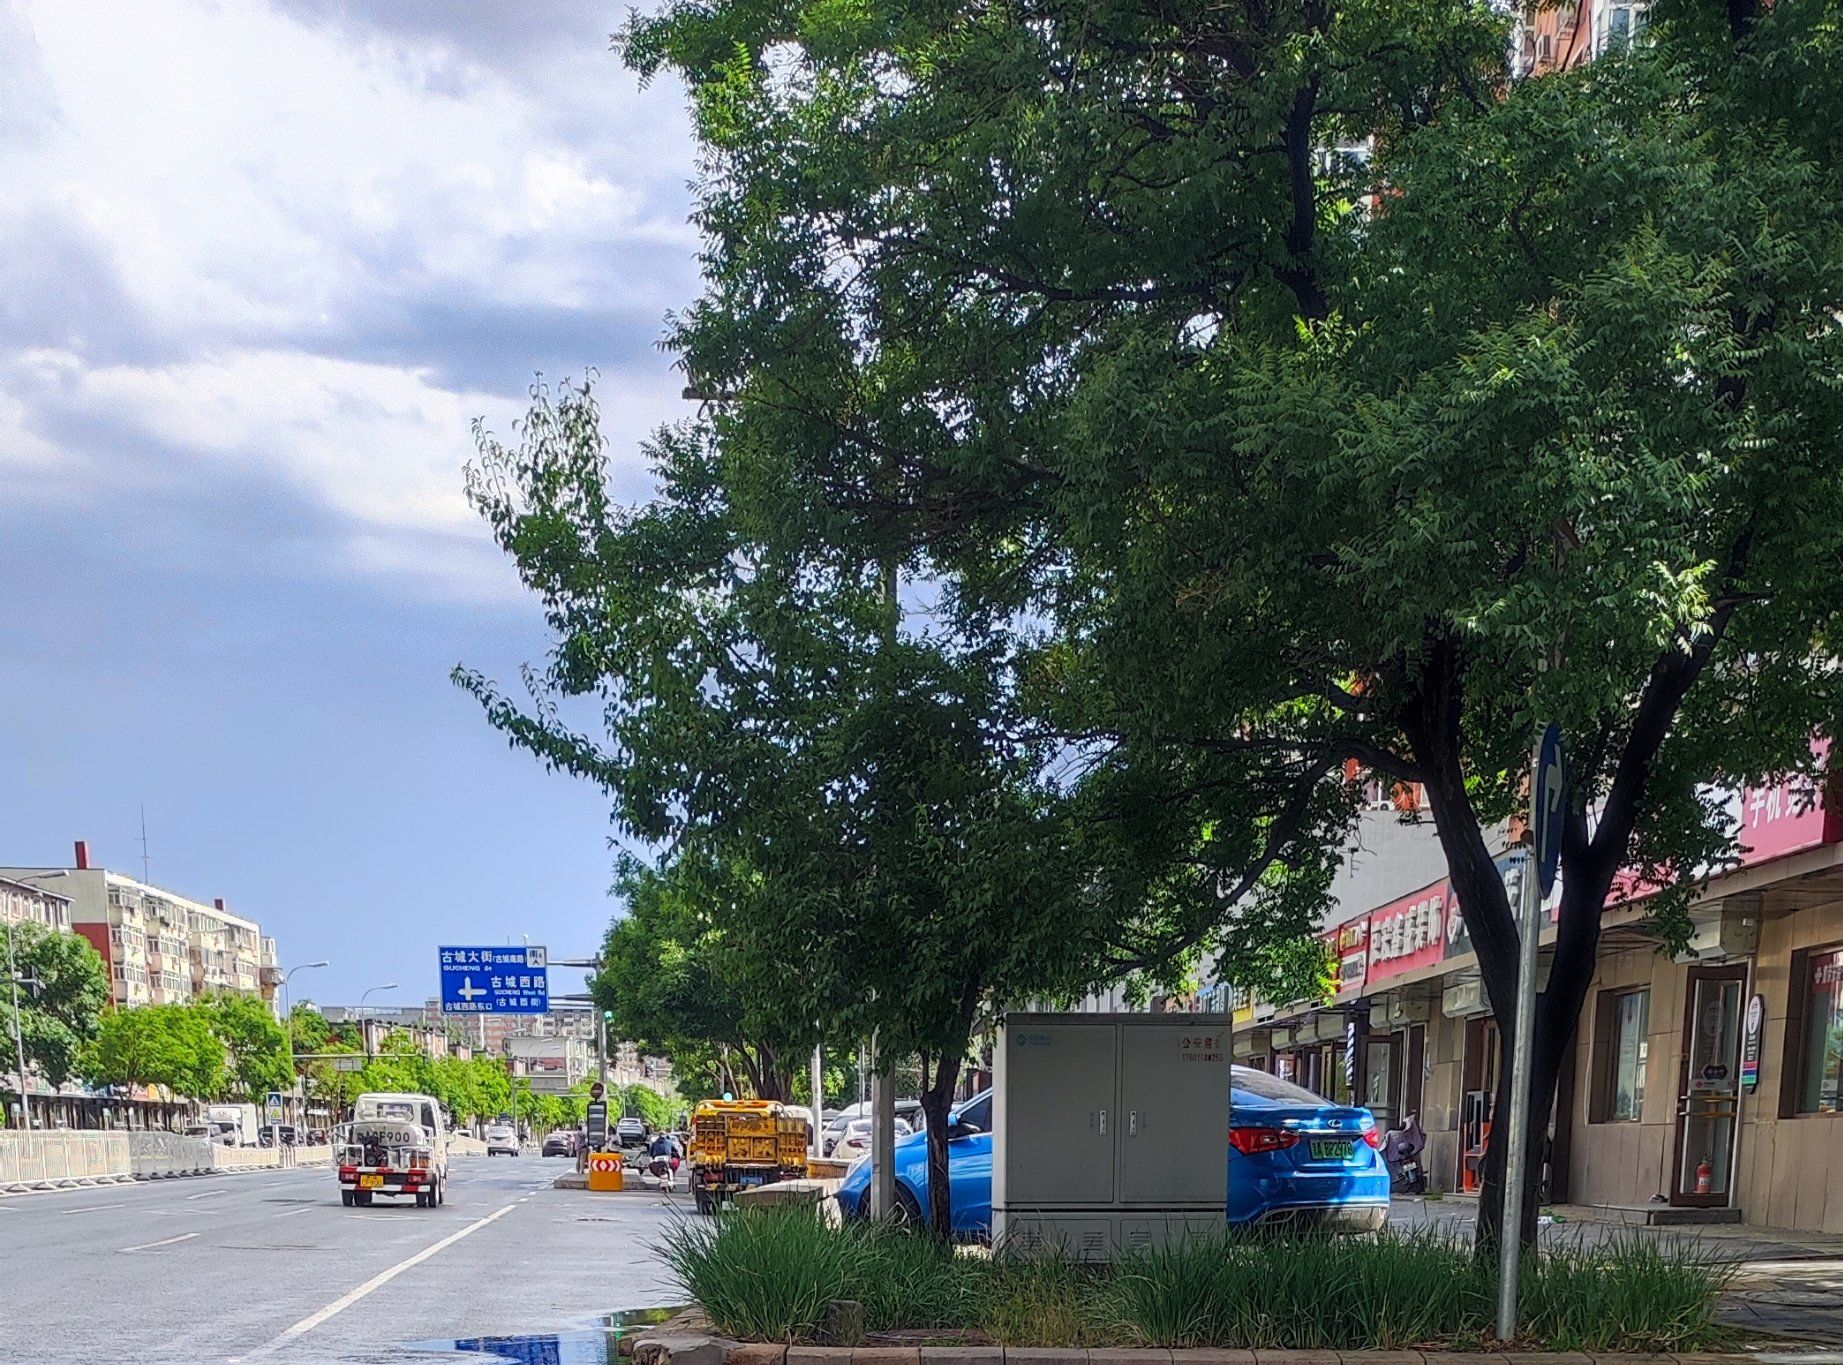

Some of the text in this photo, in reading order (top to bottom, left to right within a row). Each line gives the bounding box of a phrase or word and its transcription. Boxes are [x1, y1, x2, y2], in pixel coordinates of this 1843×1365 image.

[441, 950, 492, 963] 古城大街
[490, 975, 545, 988] 古城西路
